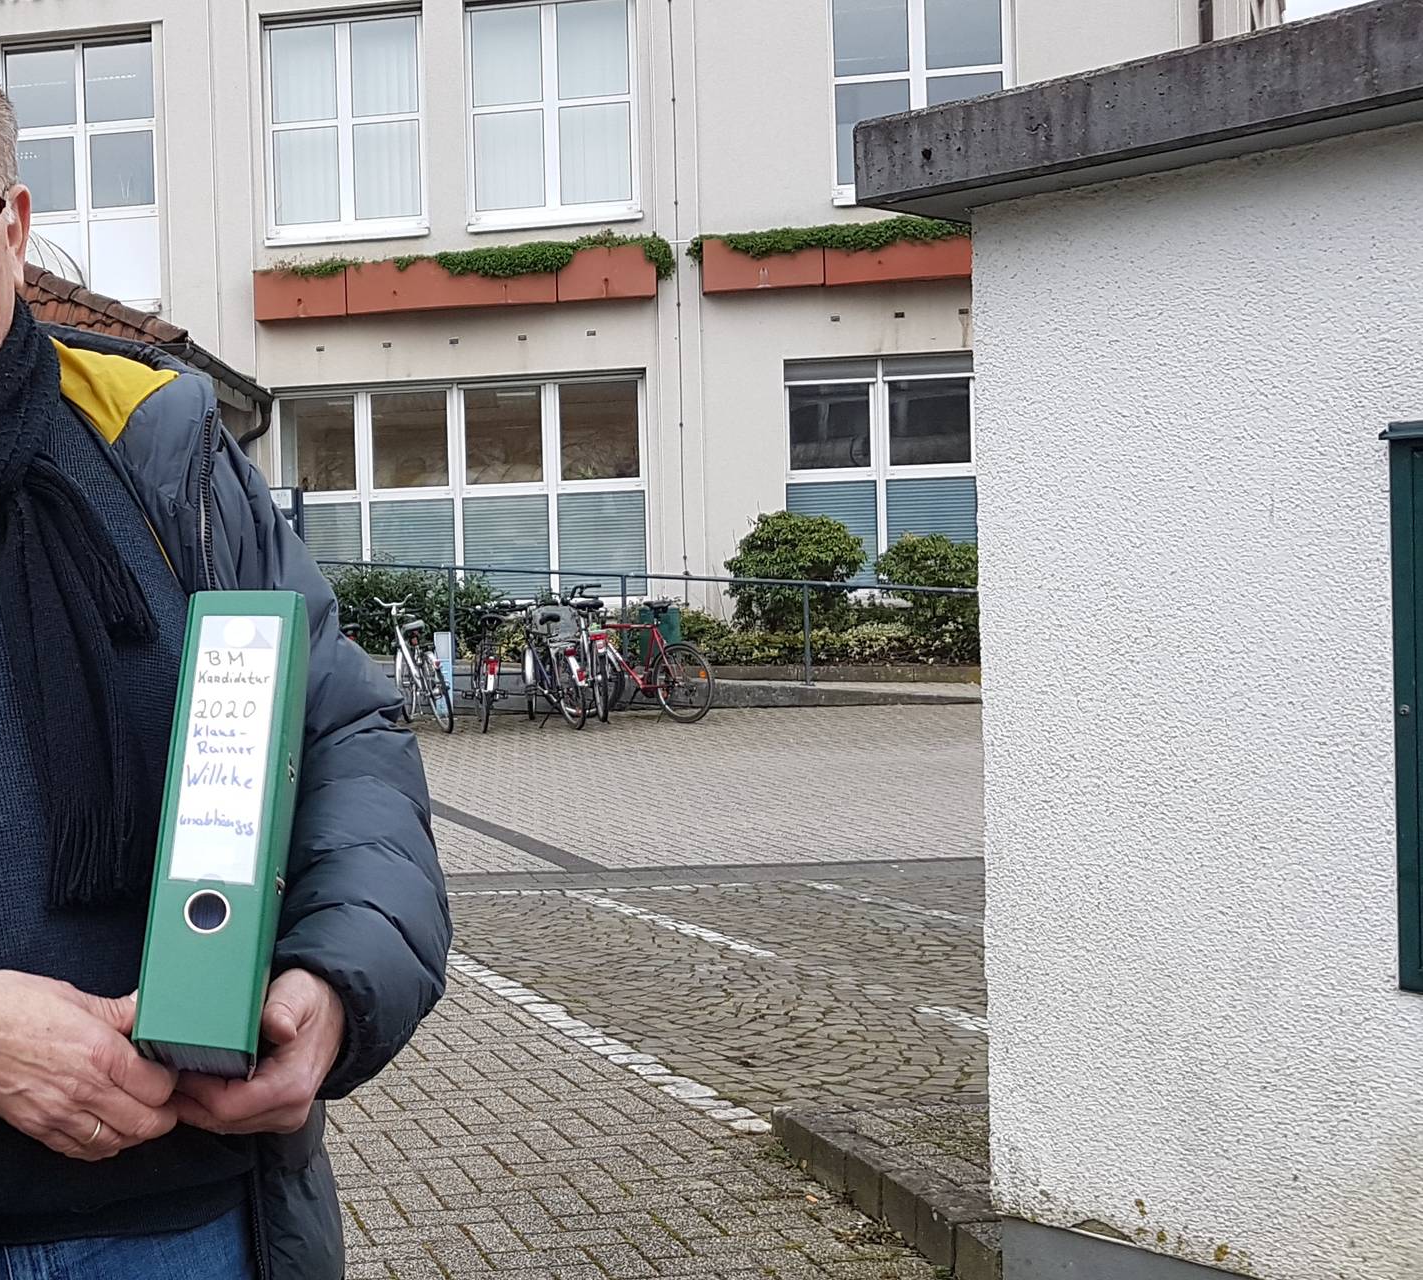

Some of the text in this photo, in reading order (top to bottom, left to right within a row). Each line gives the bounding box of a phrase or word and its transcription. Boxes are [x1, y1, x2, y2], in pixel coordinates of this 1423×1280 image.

[197, 670, 271, 685] Kandidatur
[194, 699, 257, 719] 2020
[197, 740, 255, 755] Rainer
[186, 761, 254, 789] Willeke
